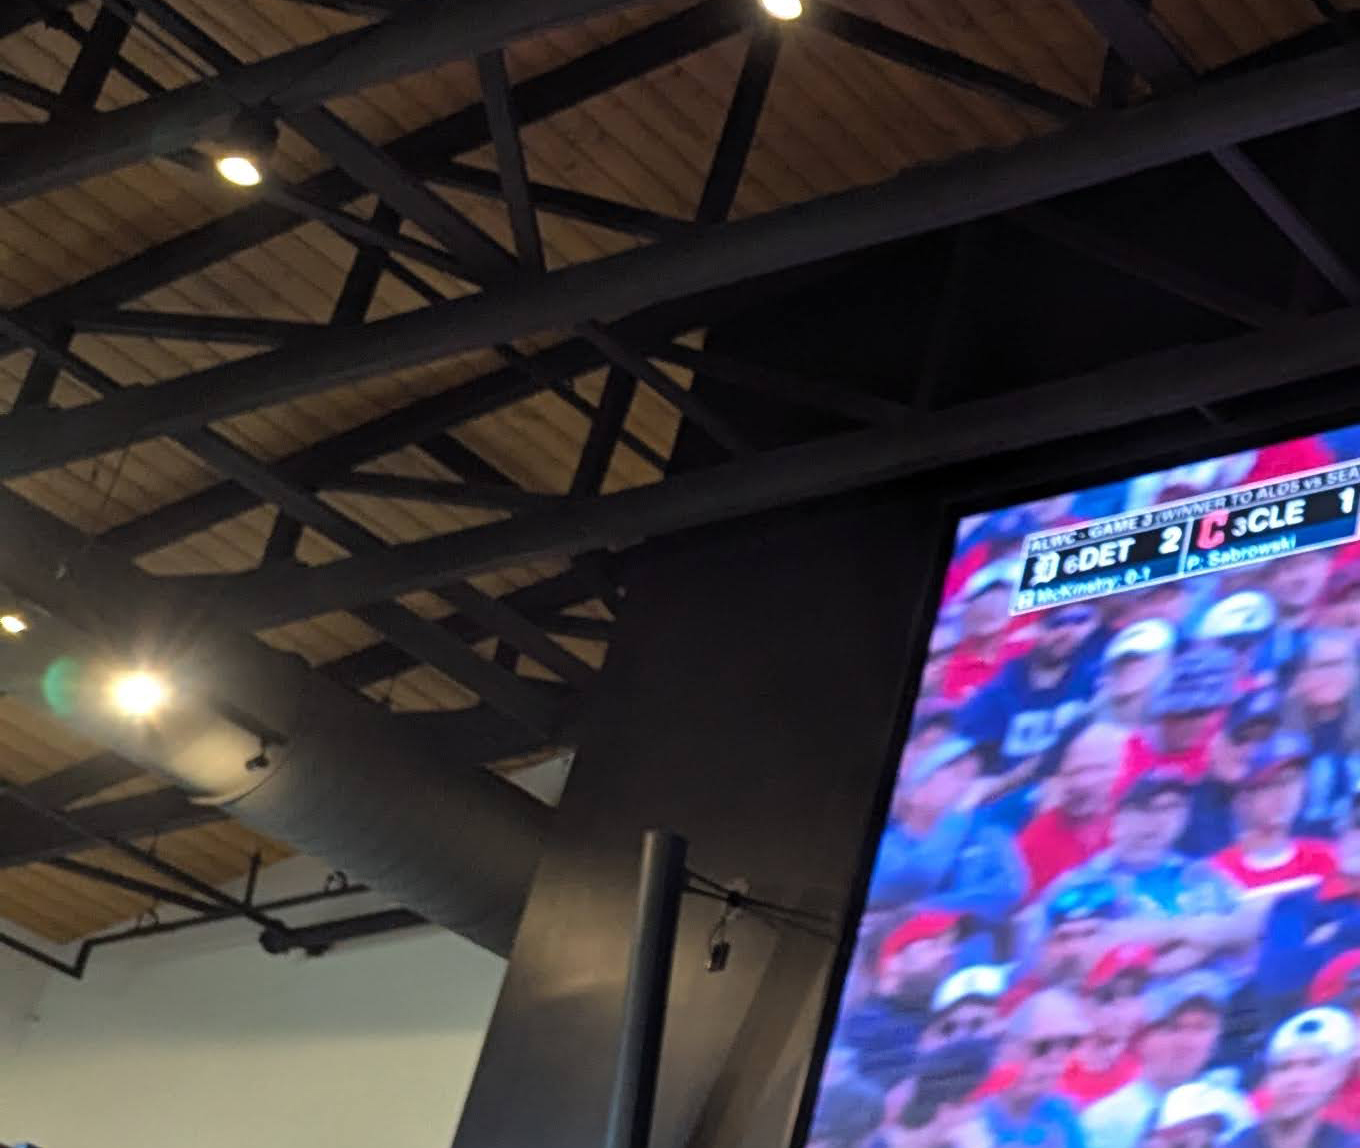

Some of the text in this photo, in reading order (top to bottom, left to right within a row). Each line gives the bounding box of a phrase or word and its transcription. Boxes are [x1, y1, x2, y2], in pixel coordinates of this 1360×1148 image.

[1087, 515, 1140, 539] GAME
[1231, 492, 1253, 507] TO
[1196, 509, 1231, 550] C
[1338, 487, 1355, 514] 1
[1158, 526, 1183, 555] 2
